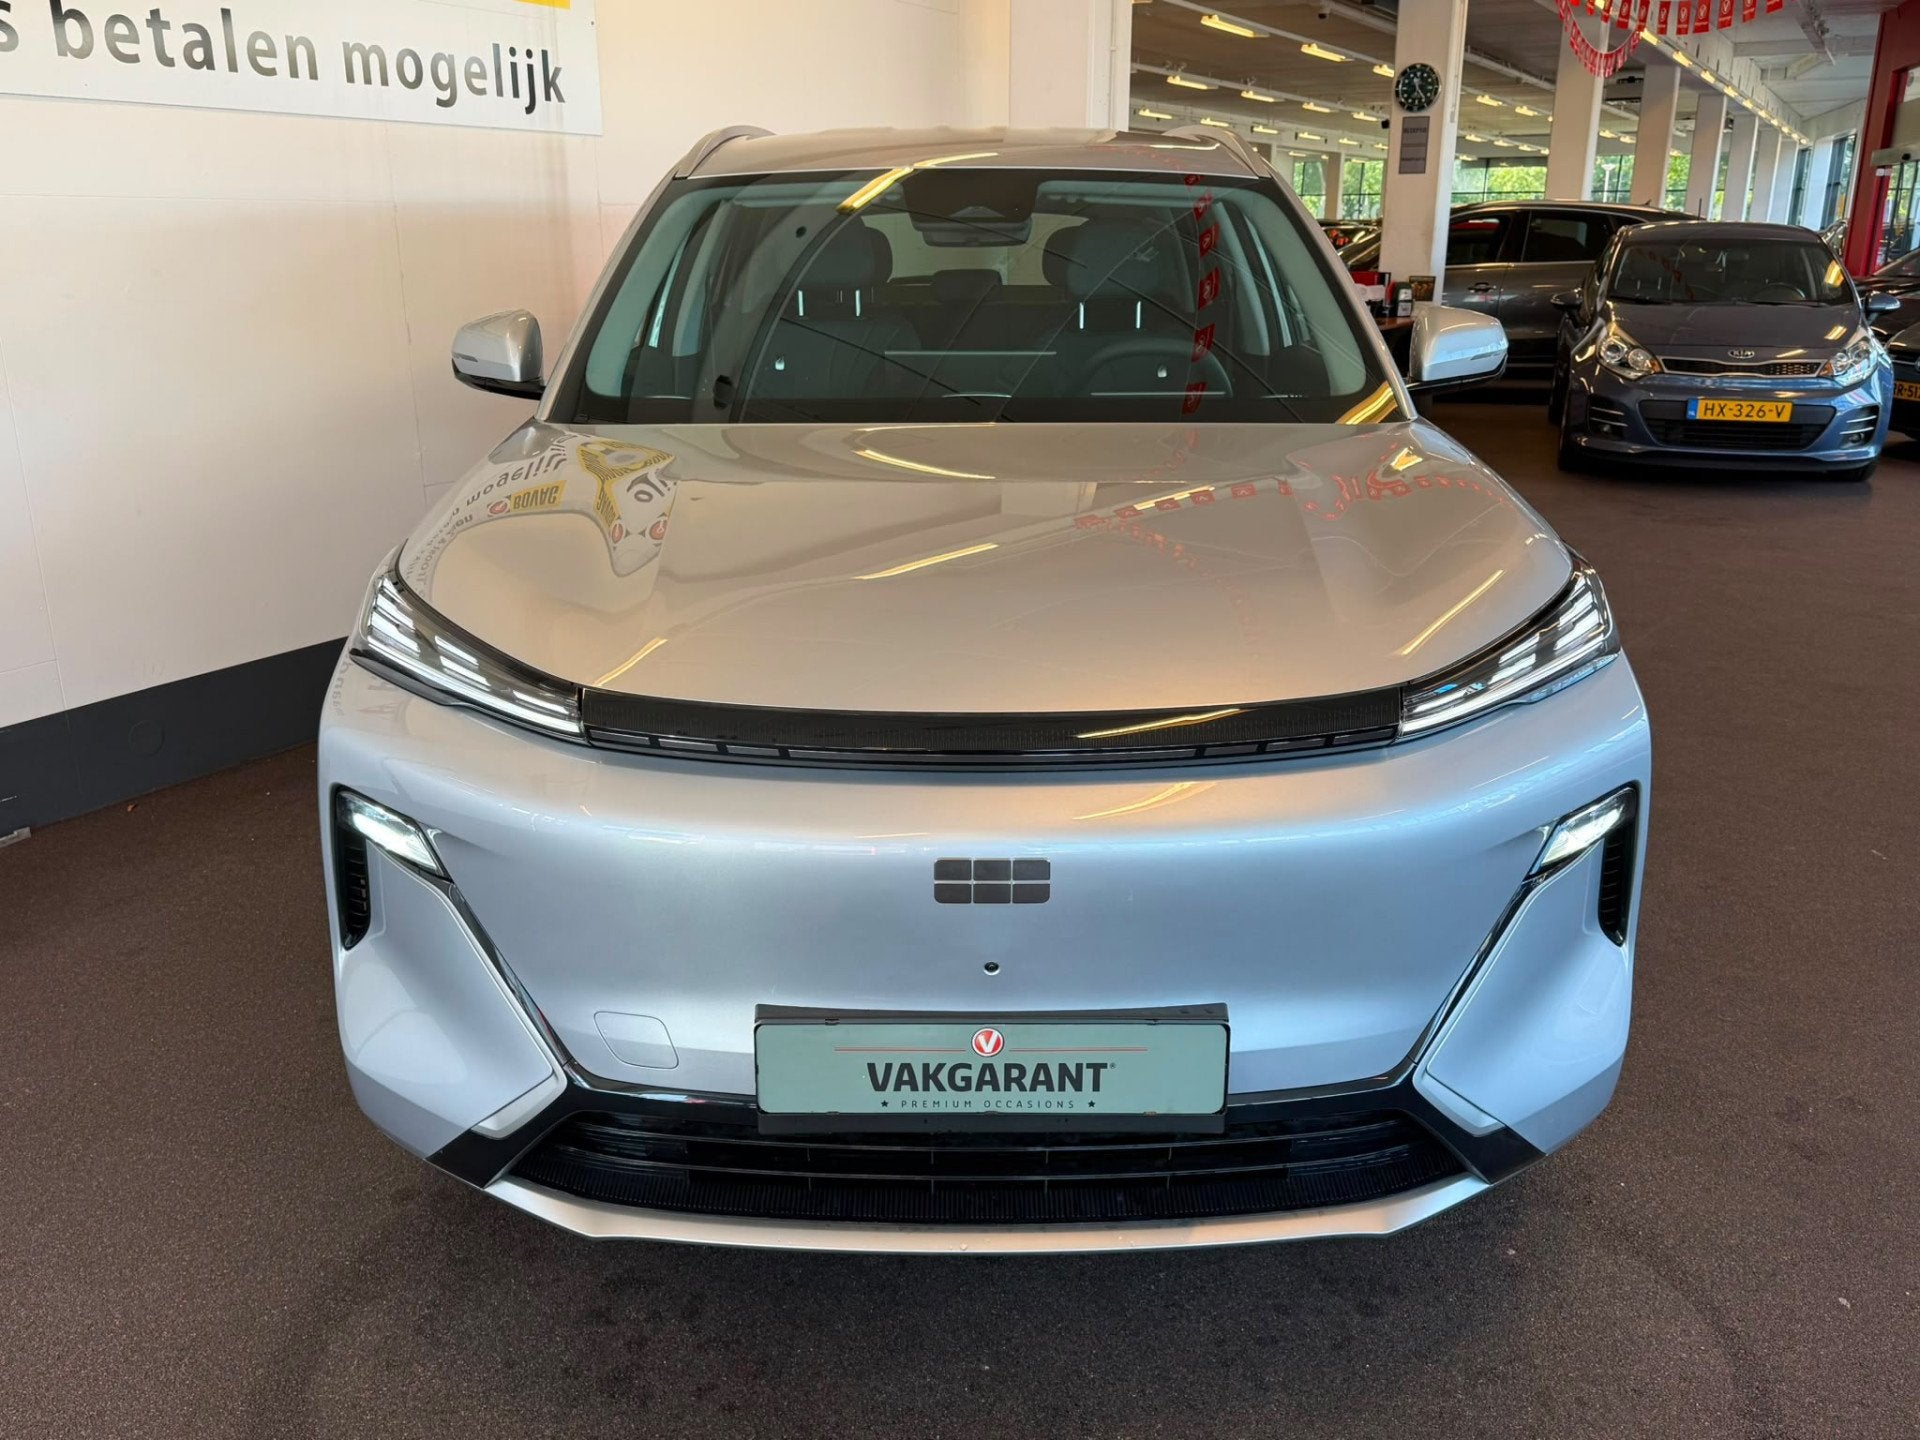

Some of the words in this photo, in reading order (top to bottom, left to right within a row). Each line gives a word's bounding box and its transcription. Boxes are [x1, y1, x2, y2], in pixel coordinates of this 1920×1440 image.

[51, 0, 319, 81] betalen
[343, 41, 566, 116] mogelijk
[1703, 402, 1786, 419] HX-326-V
[866, 1062, 1109, 1093] VAKGARANT
[901, 1099, 973, 1109] PREMIUM
[983, 1099, 1075, 1109] OCCASIONS
